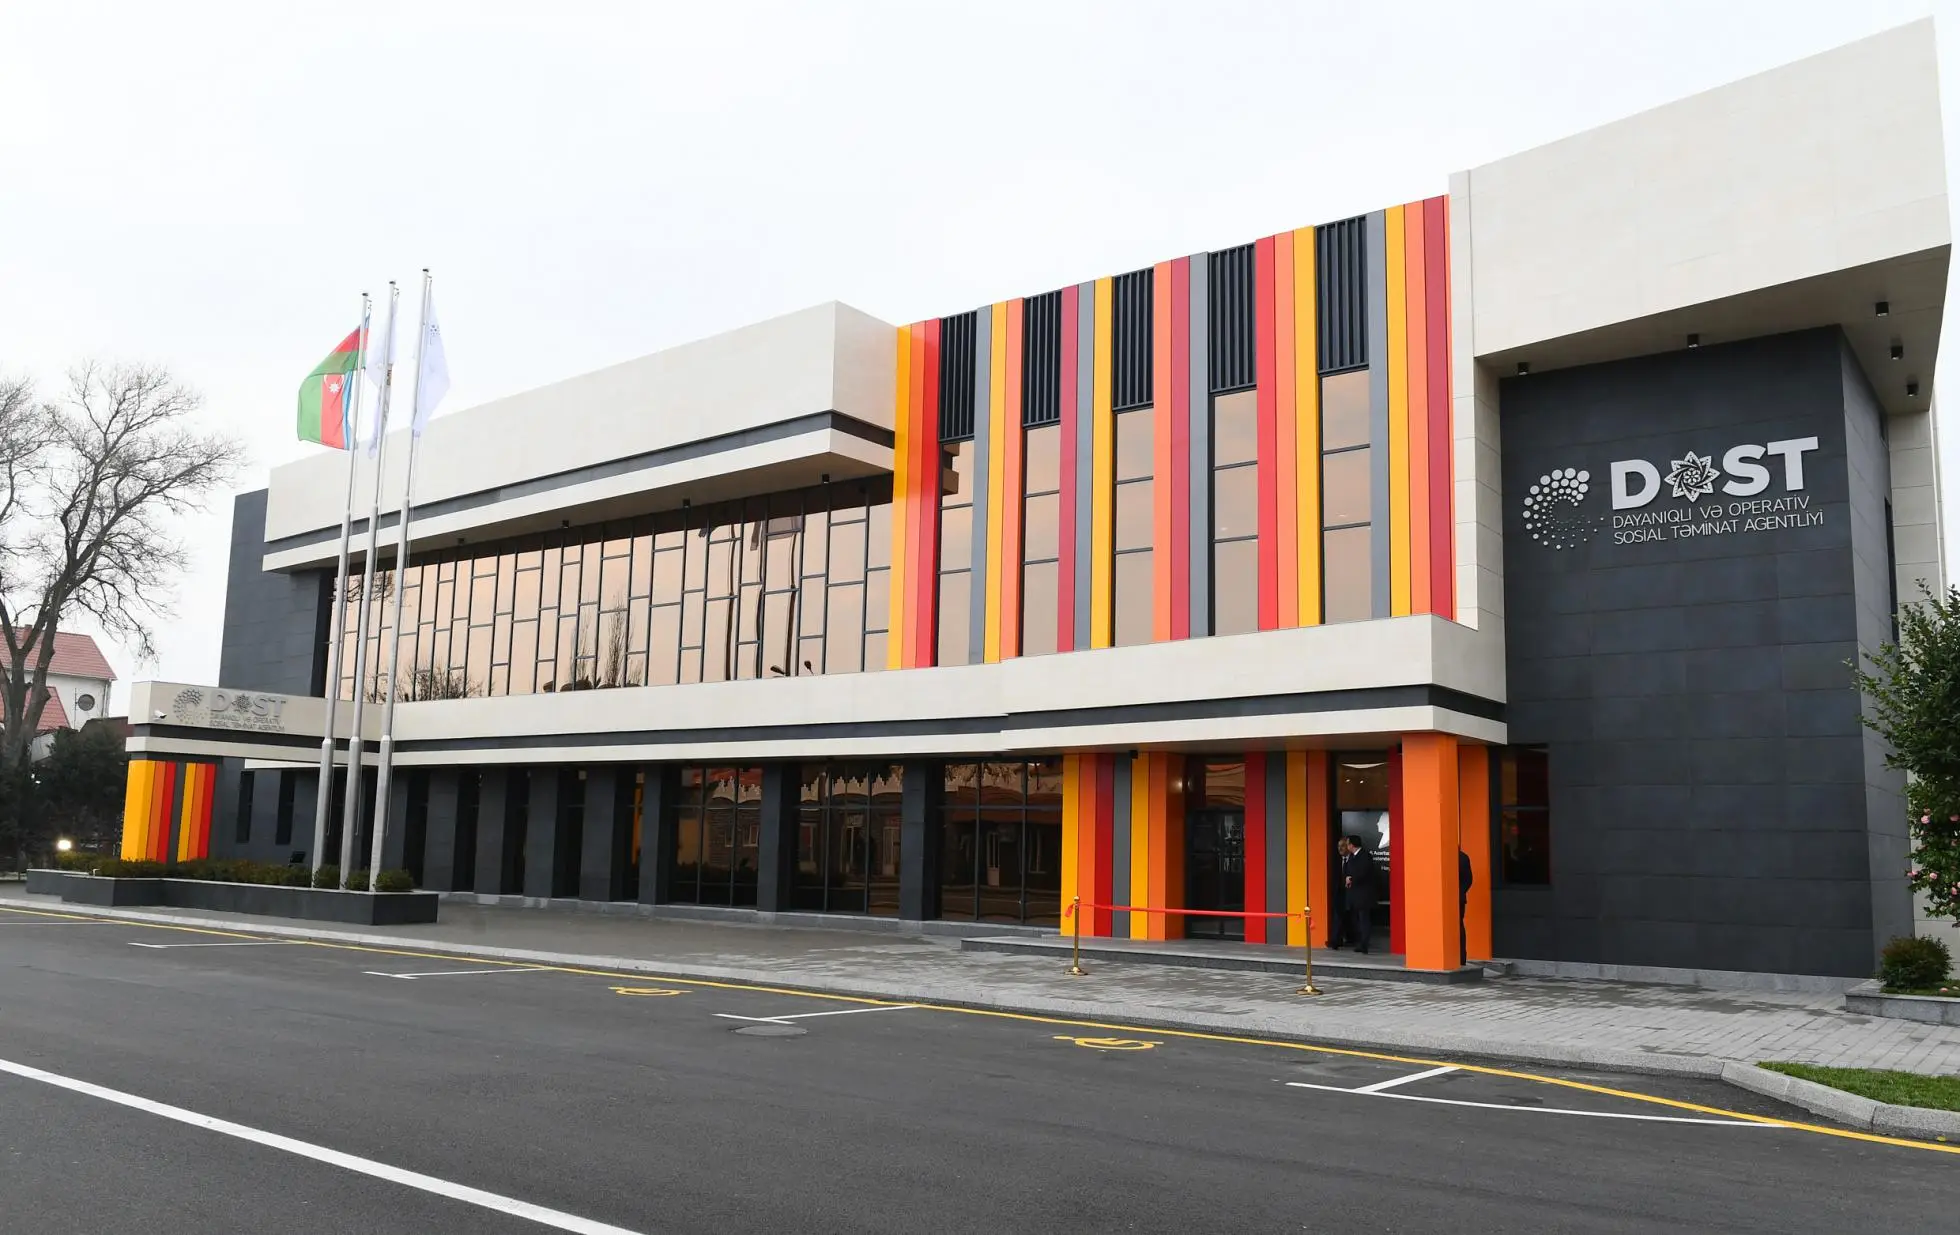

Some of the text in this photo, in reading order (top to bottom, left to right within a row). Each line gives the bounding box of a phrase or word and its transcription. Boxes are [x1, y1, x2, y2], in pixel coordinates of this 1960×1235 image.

[1613, 494, 1810, 529] DAYANIQLI VƏ OPERATİV
[1614, 508, 1824, 545] SOSİAL TƏMİNAT AGENTLİYİ
